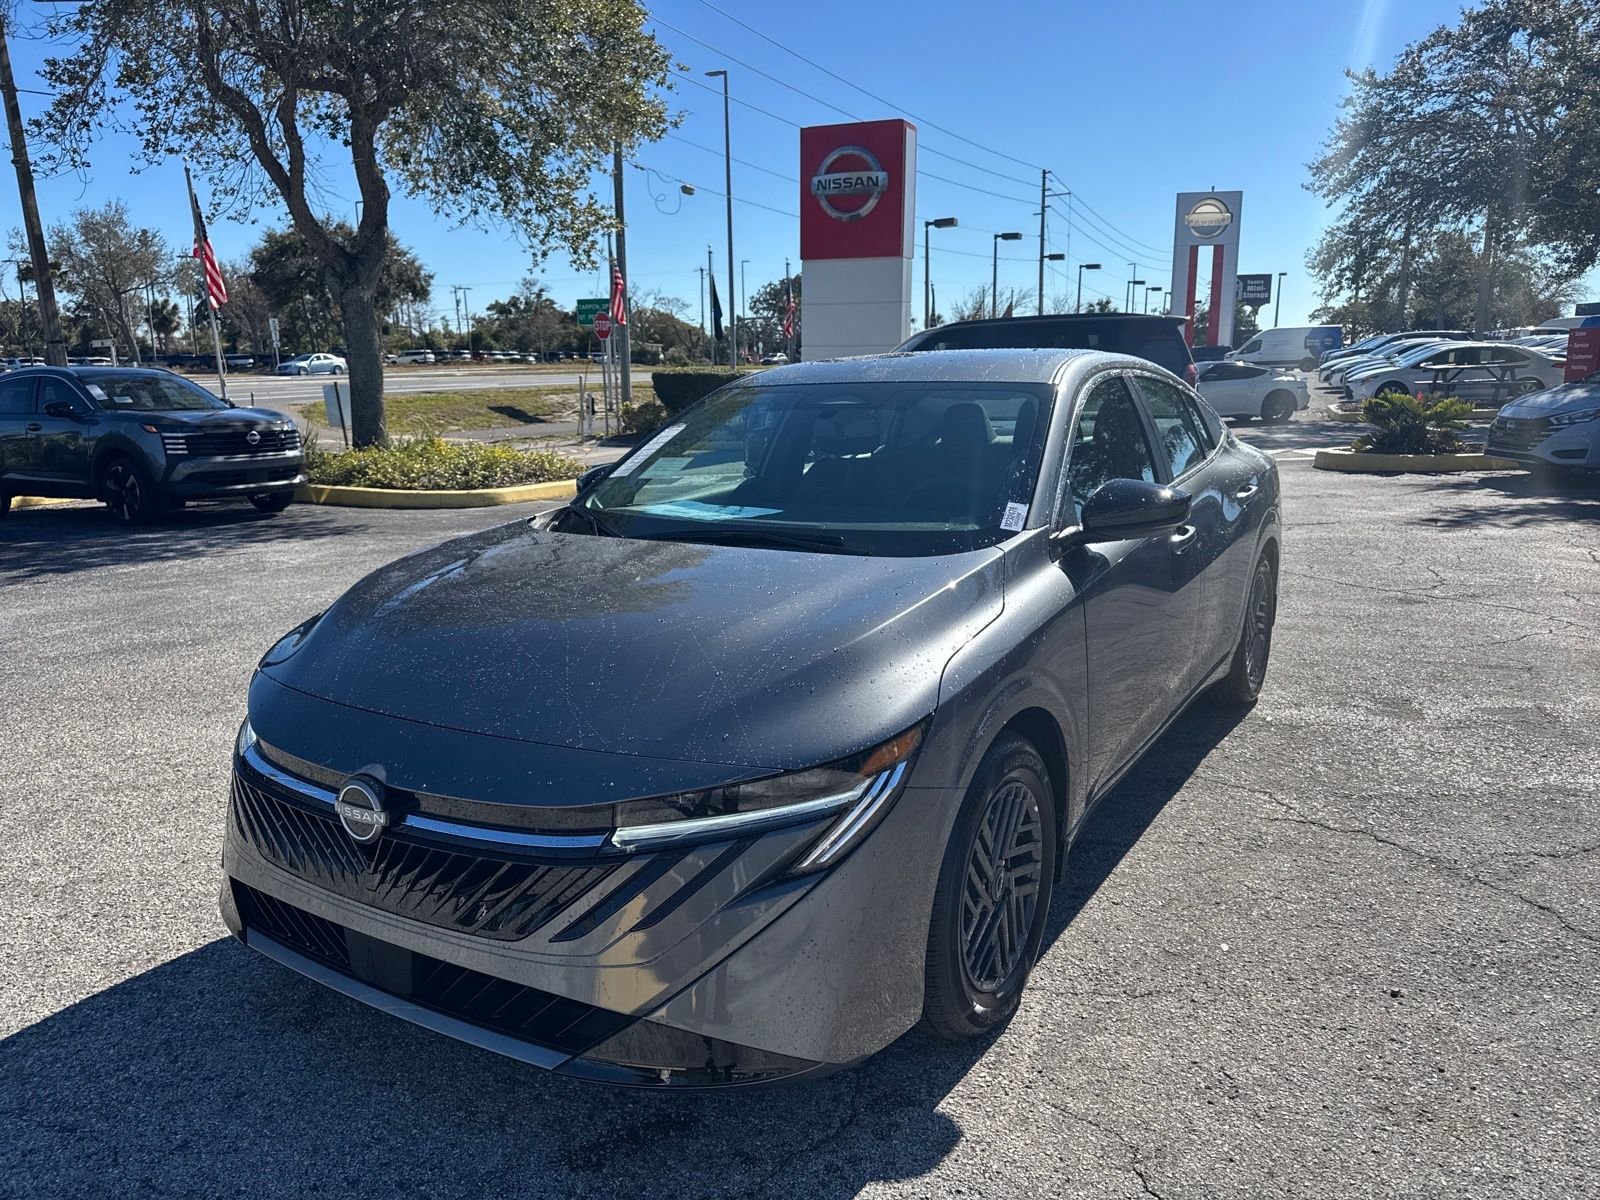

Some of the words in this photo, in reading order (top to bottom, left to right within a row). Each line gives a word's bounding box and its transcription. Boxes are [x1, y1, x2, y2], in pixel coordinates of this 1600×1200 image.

[816, 175, 880, 192] NISSAN
[595, 320, 610, 331] STOP
[335, 803, 384, 823] NISSAN
